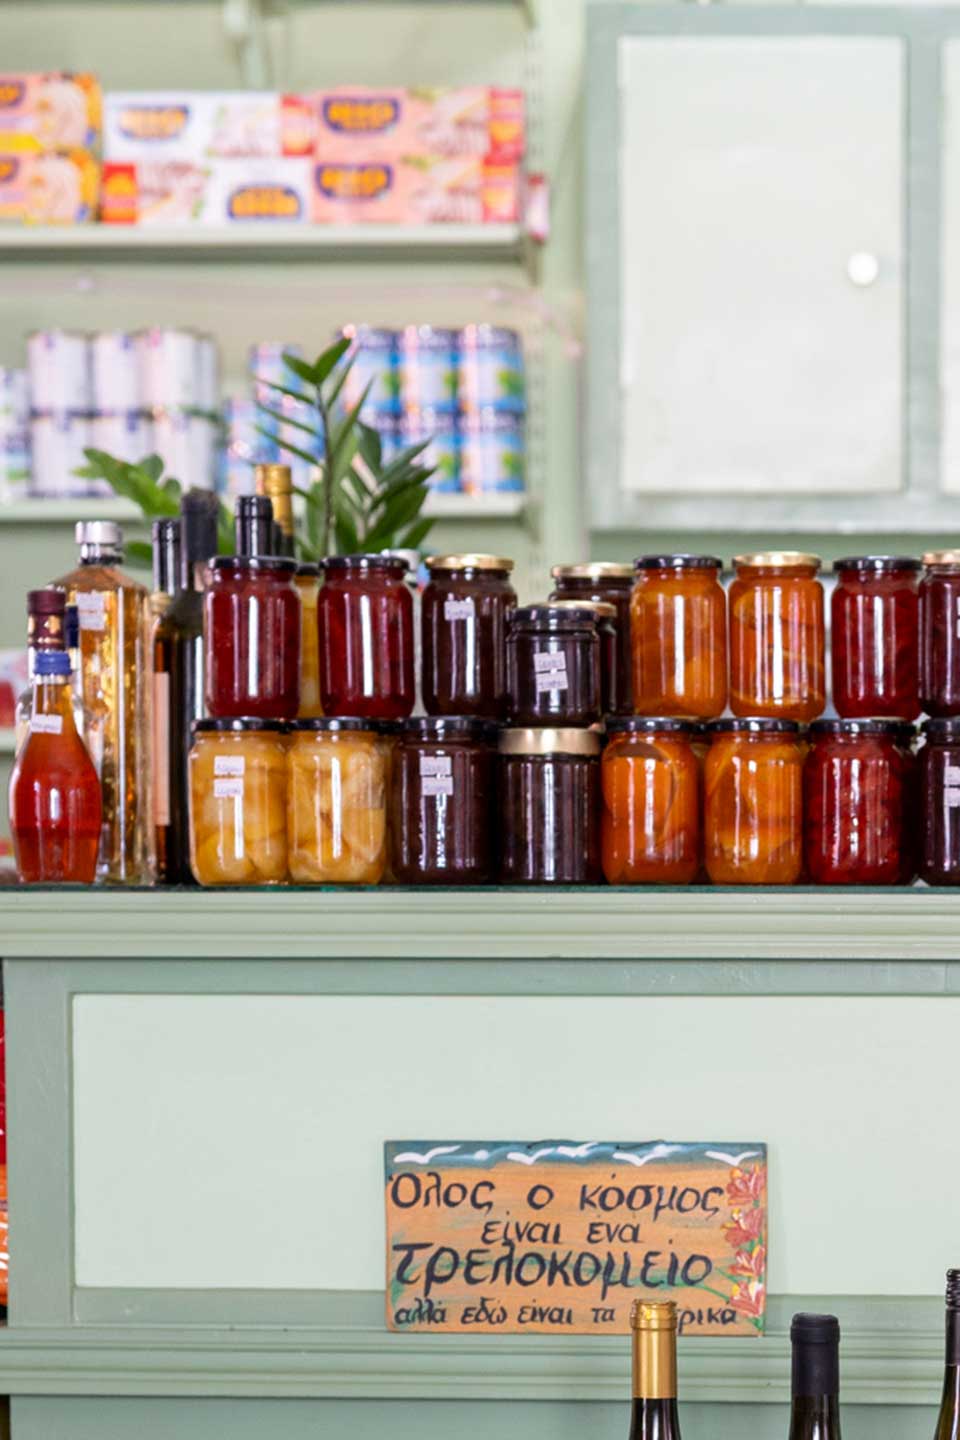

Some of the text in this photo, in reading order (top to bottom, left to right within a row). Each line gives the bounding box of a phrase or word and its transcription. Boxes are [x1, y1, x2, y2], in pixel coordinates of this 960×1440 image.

[579, 1173, 725, 1222] κόσμος
[480, 1210, 564, 1245] είναι
[394, 1297, 449, 1326] αλλά
[460, 1296, 508, 1326] εδώ
[591, 1306, 617, 1324] τα
